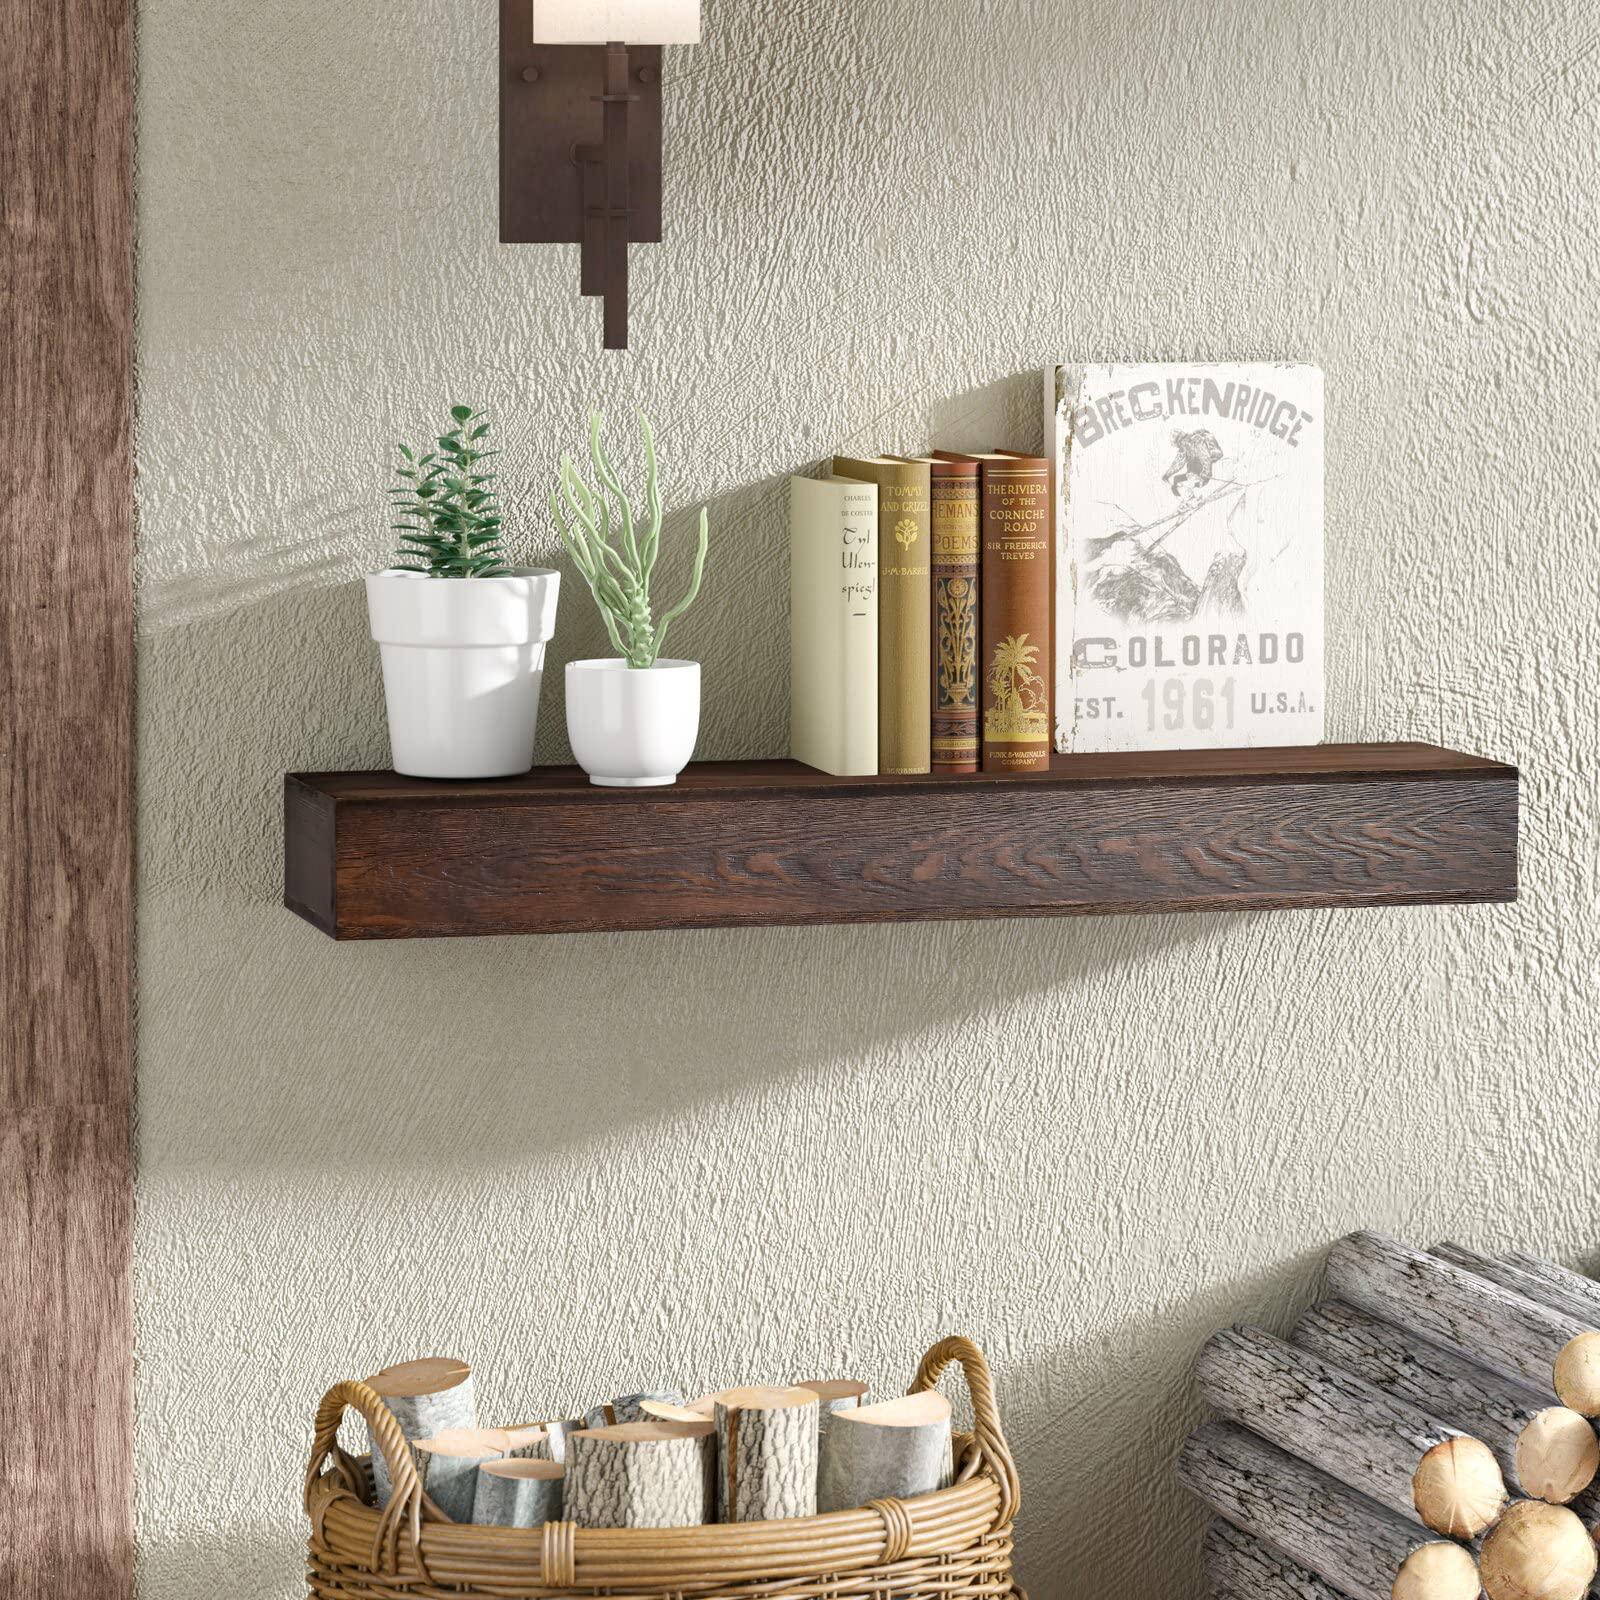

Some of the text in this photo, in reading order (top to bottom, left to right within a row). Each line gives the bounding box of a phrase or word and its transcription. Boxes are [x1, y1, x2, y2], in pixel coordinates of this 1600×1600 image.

[1073, 377, 1314, 450] BRECKENRIDGE
[886, 486, 923, 497] TOMMY
[987, 484, 1047, 495] THE RIVIERA
[989, 510, 1045, 520] CORNICHE
[1004, 522, 1037, 532] ROAD
[934, 534, 978, 550] POEMS
[986, 541, 1047, 551] SIR FREDERICK
[1001, 552, 1035, 560] TREVES
[1072, 632, 1304, 670] COLORADO
[1075, 676, 1315, 732] EST. 1961 U.S.A.
